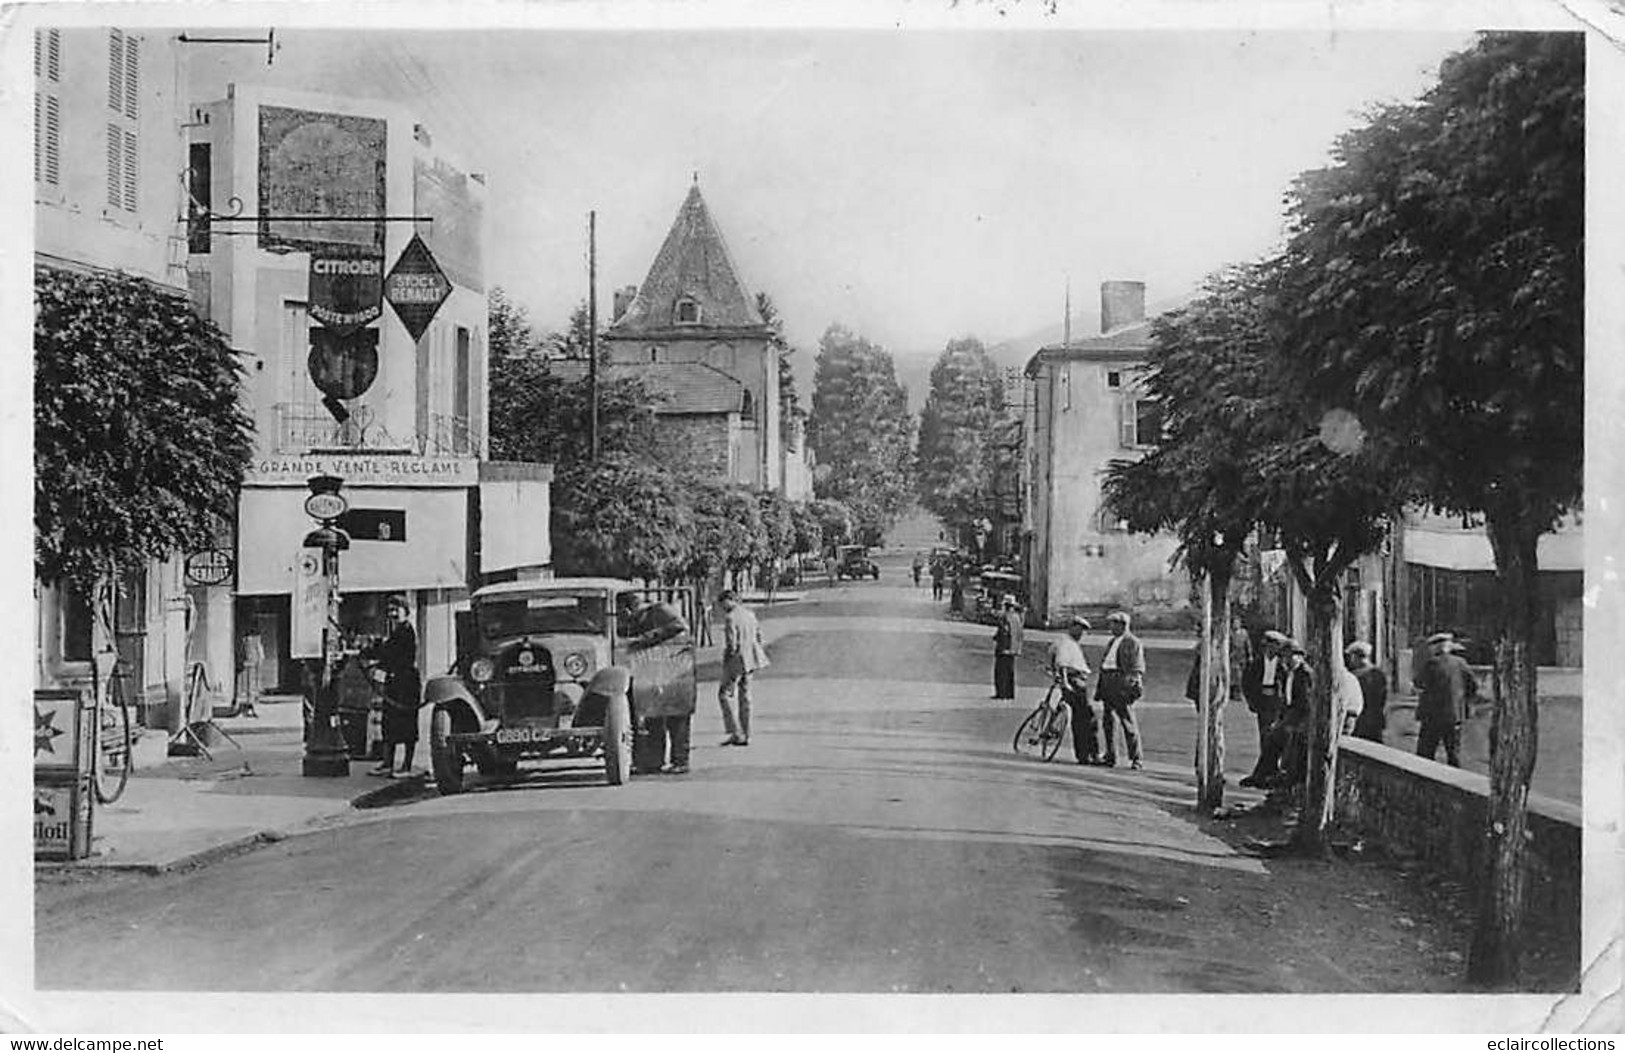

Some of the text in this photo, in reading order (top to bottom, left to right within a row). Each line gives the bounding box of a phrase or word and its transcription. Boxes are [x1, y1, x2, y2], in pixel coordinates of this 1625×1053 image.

[396, 276, 436, 287] STOCK
[391, 287, 441, 302] RENAULT
[260, 461, 323, 474] GRANDE
[332, 460, 380, 474] VENTE
